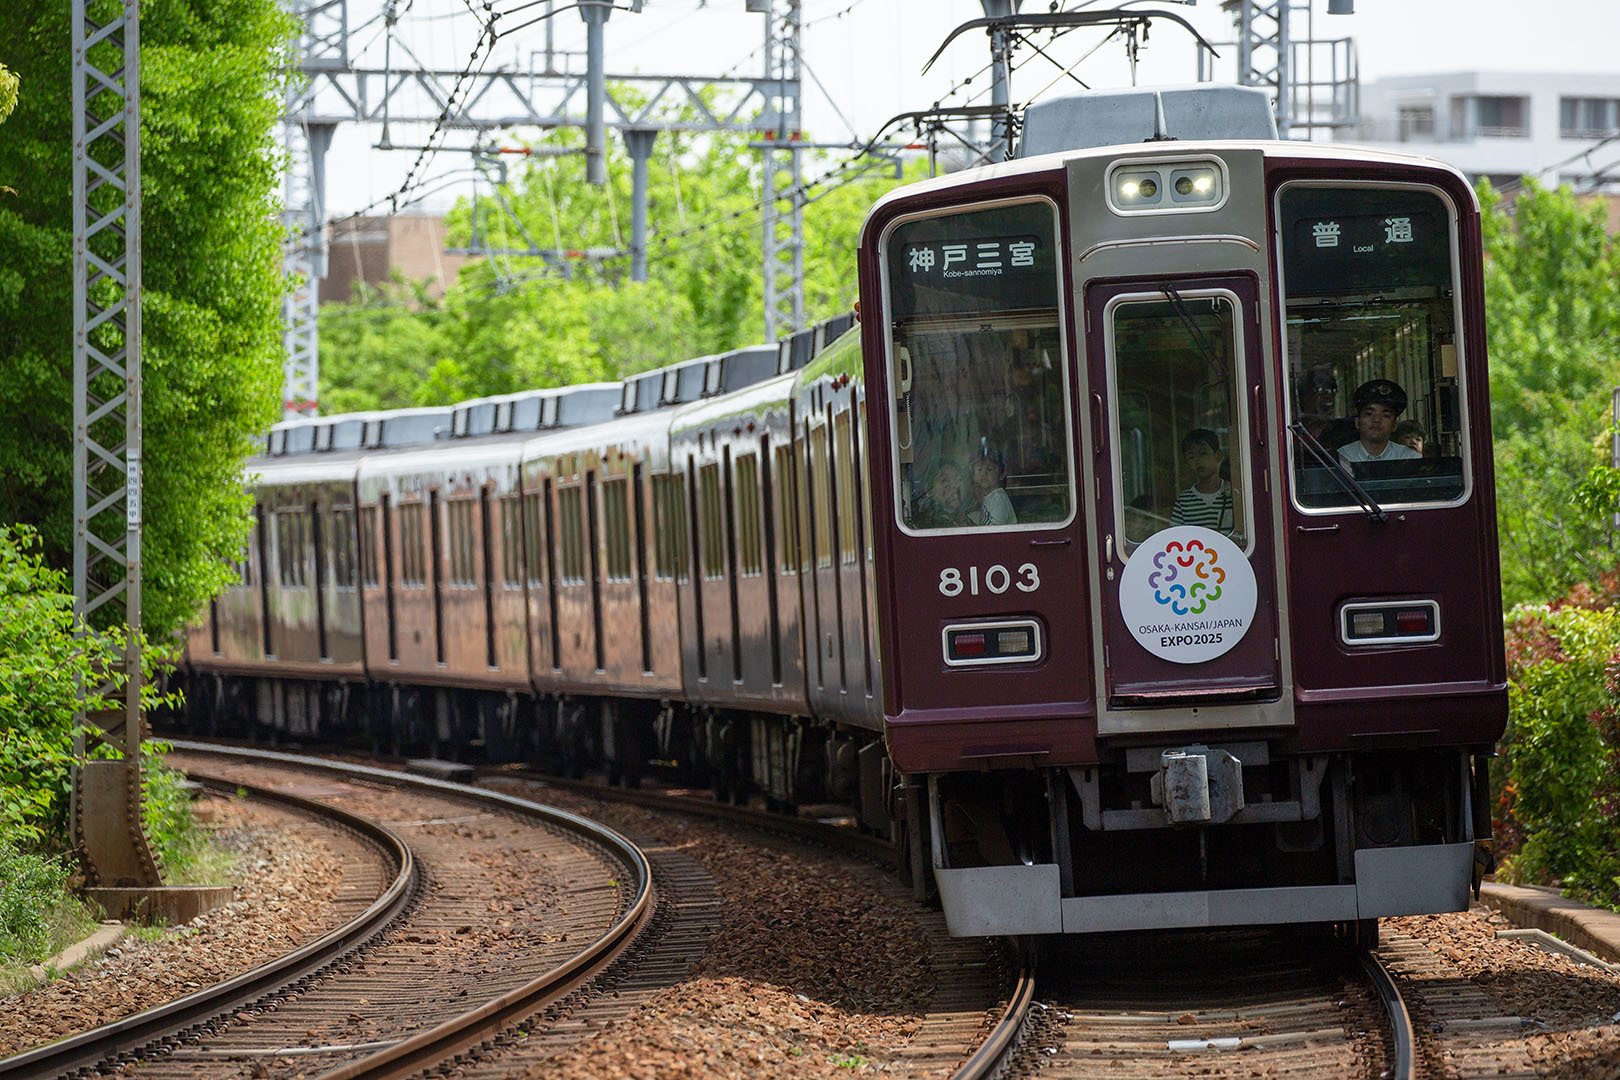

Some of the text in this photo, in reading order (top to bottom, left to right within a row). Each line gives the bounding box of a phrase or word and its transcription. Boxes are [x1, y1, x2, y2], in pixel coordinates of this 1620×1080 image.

[1312, 217, 1414, 248] 普通
[909, 241, 1036, 273] 神戸三宮
[1353, 244, 1374, 253] Local
[943, 268, 1003, 278] Kobe-sannomiya
[938, 562, 1041, 597] 8103
[1138, 618, 1243, 635] OSAKA-KANSAI/JAPAN
[1160, 632, 1223, 648] EXPO2025
